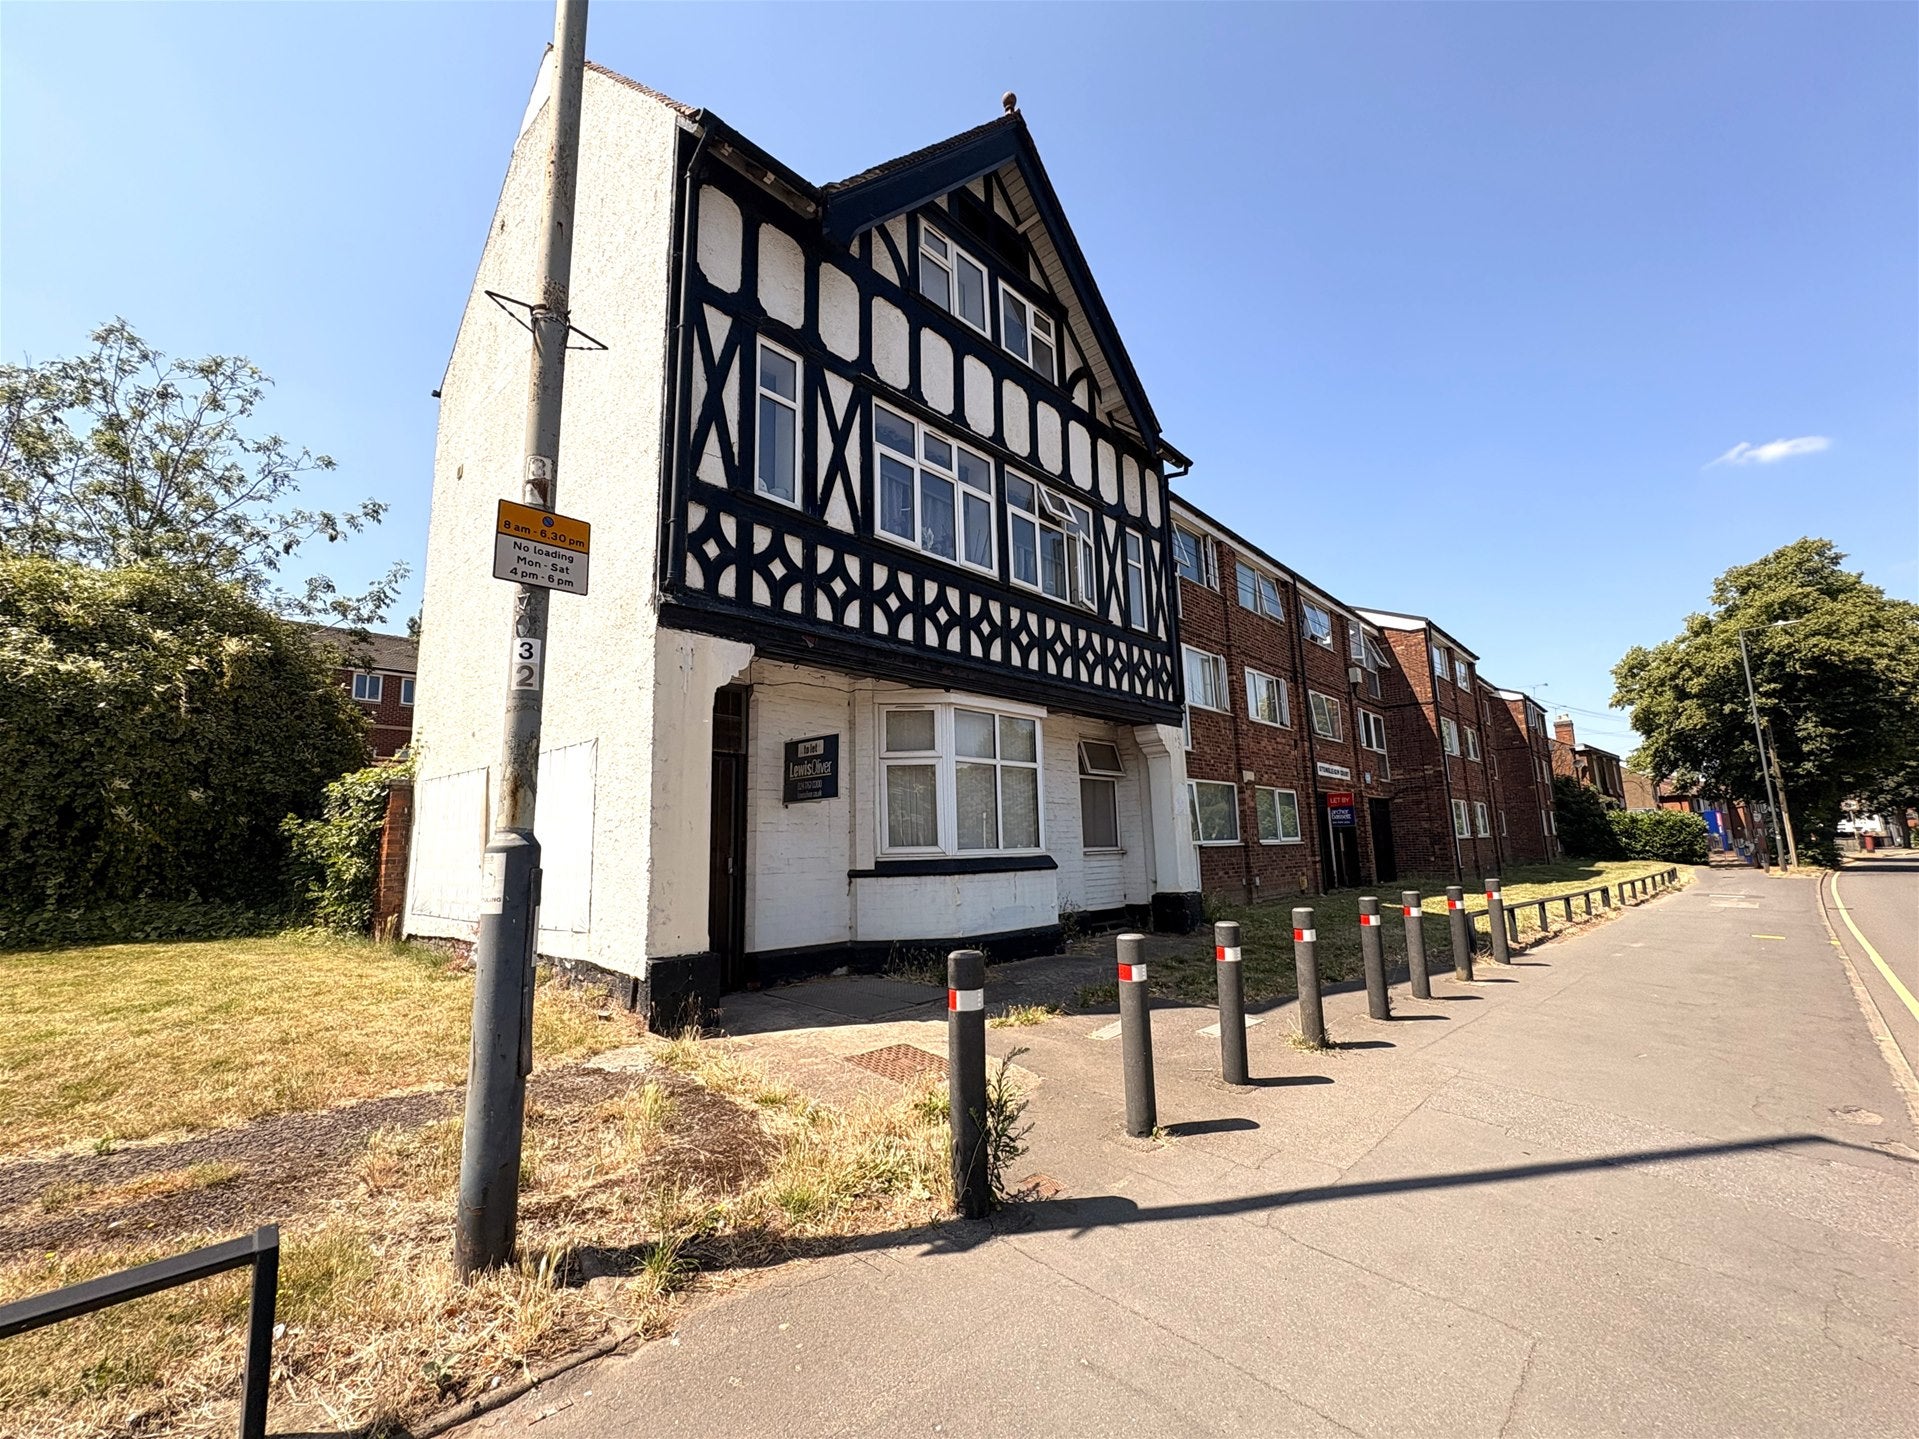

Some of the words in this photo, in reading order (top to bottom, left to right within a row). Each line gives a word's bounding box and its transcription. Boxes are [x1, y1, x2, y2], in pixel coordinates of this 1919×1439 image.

[503, 520, 511, 529] 8
[514, 524, 530, 534] am
[540, 529, 566, 542] 6.30
[569, 539, 585, 548] pm
[513, 541, 529, 552] No
[534, 546, 574, 563] loading
[517, 556, 541, 568] Mon
[551, 563, 570, 574] Sat
[509, 567, 518, 576] 4
[521, 570, 538, 580] pm
[547, 574, 555, 583] 6
[557, 578, 574, 587] pm
[518, 642, 534, 660] 3
[516, 665, 534, 687] 2
